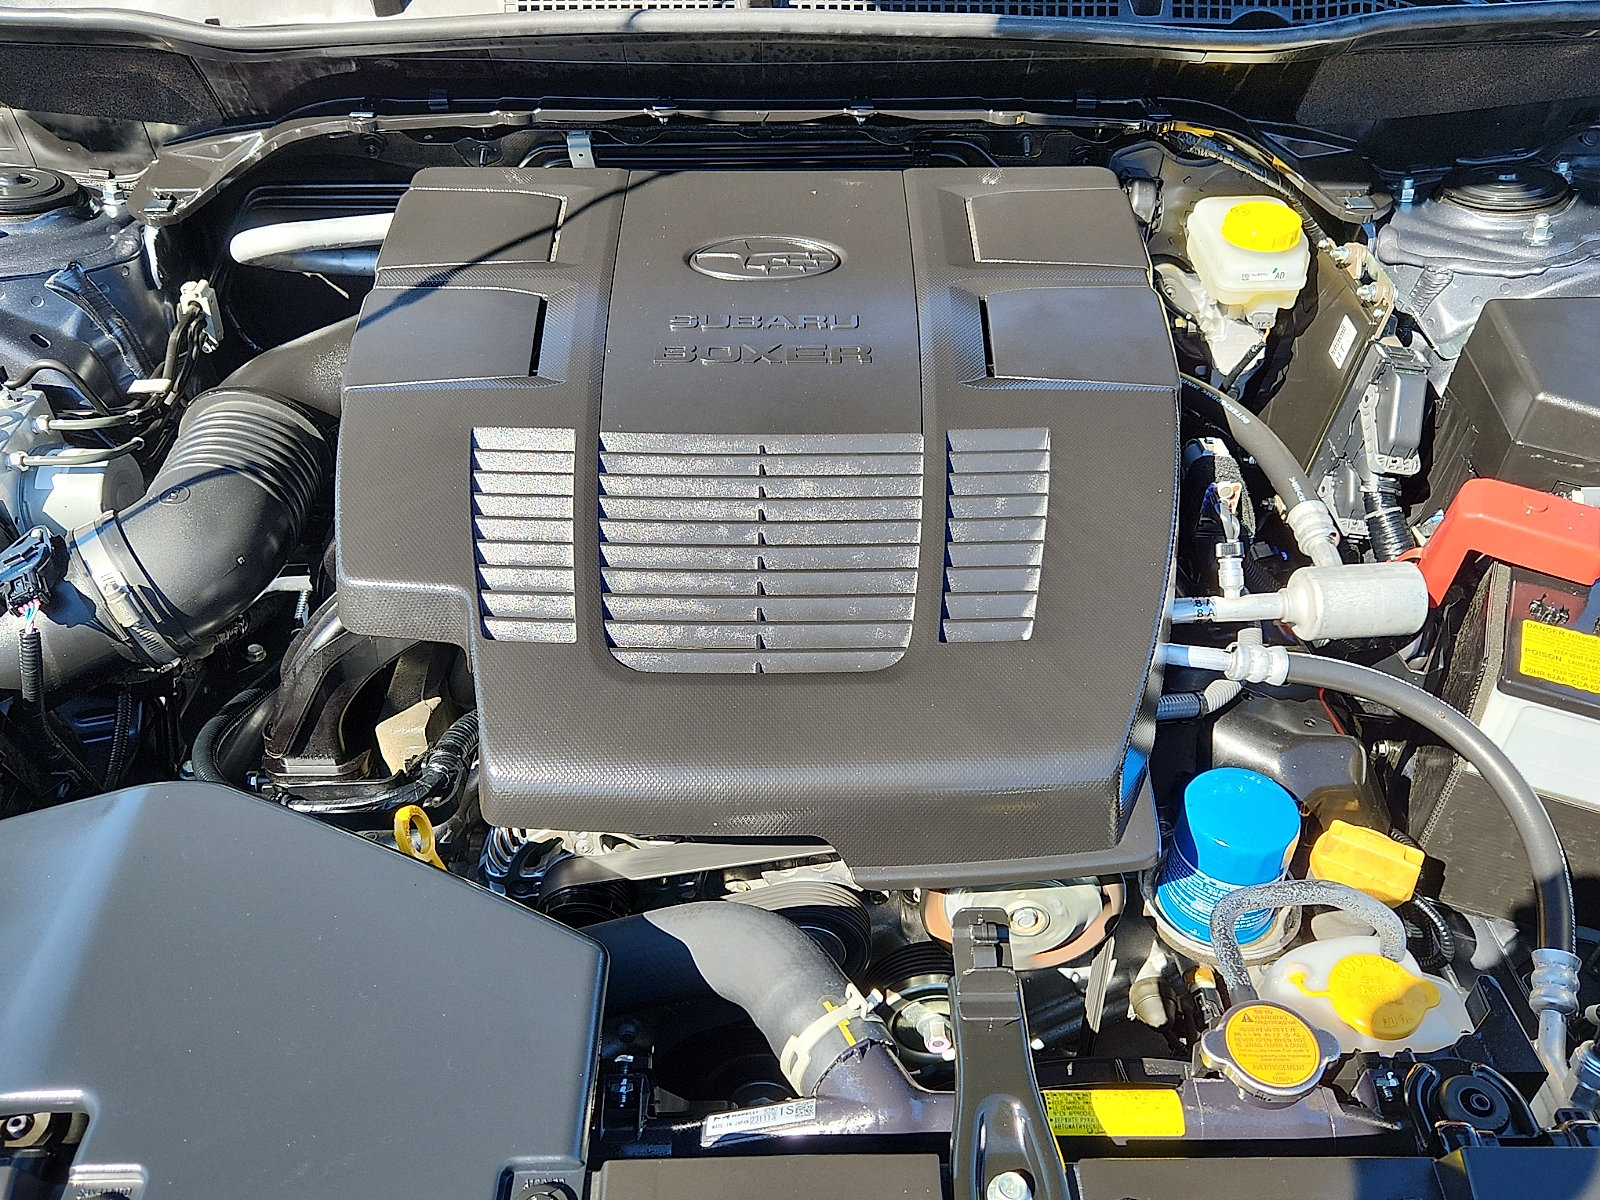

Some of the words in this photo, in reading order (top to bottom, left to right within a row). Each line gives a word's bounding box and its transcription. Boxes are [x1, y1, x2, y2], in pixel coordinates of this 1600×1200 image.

[669, 314, 860, 330] SUBARU
[654, 344, 873, 365] BOXER
[1526, 622, 1565, 636] DANGER
[1525, 647, 1562, 661] POISON
[1571, 680, 1590, 688] CCA
[1335, 956, 1410, 980] COOLANT
